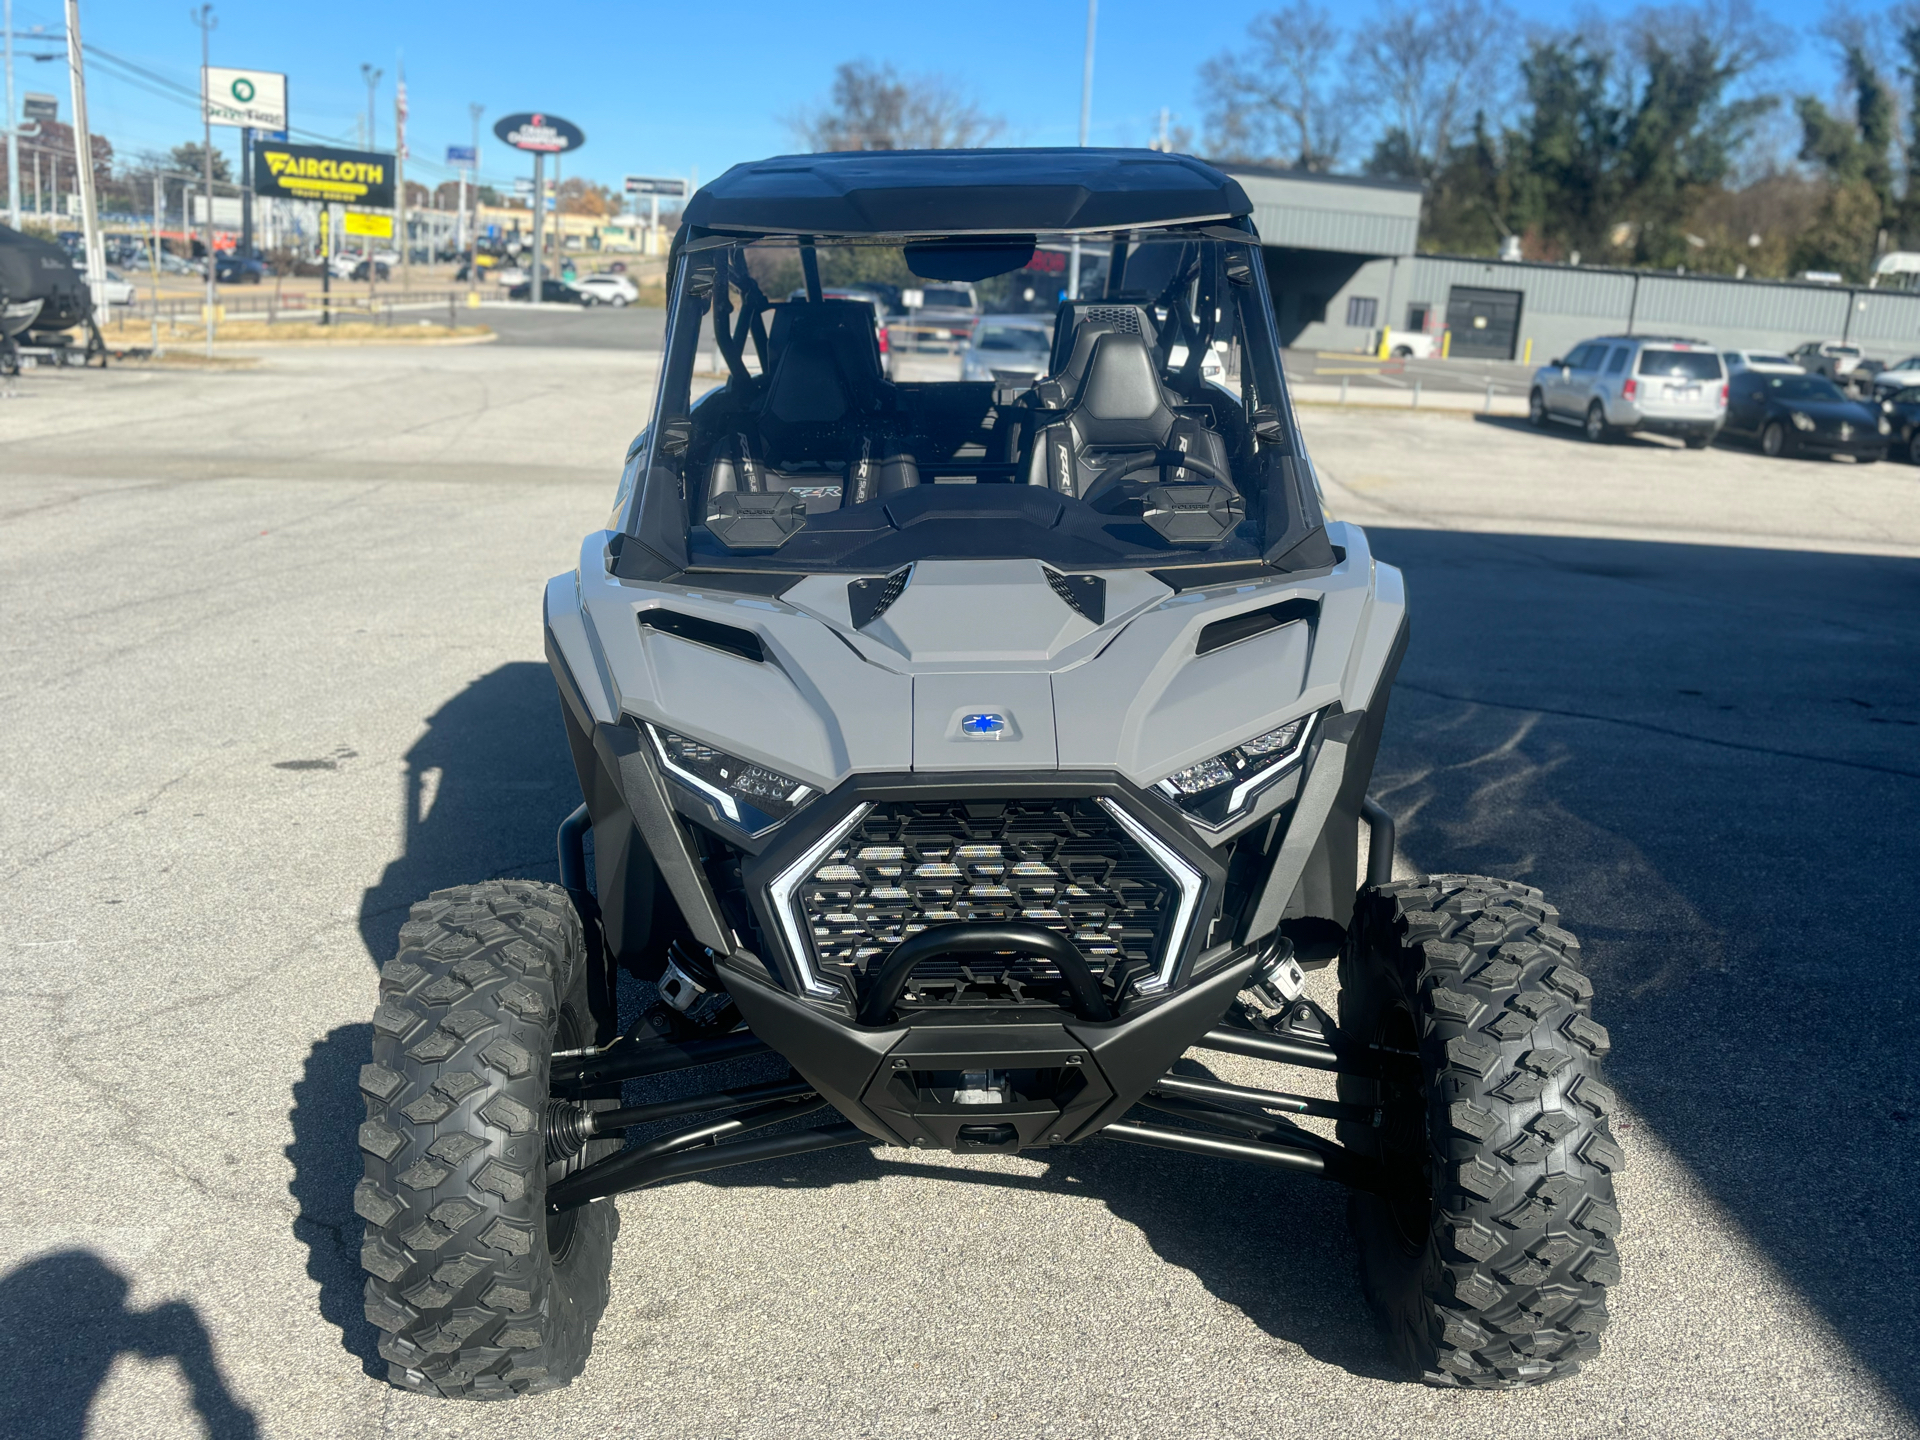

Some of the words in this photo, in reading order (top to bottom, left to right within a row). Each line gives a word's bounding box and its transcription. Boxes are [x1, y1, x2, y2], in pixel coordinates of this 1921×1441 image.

[263, 151, 383, 185] FAIRCLOTH
[1057, 443, 1070, 487] RZR
[1176, 435, 1188, 479] RR
